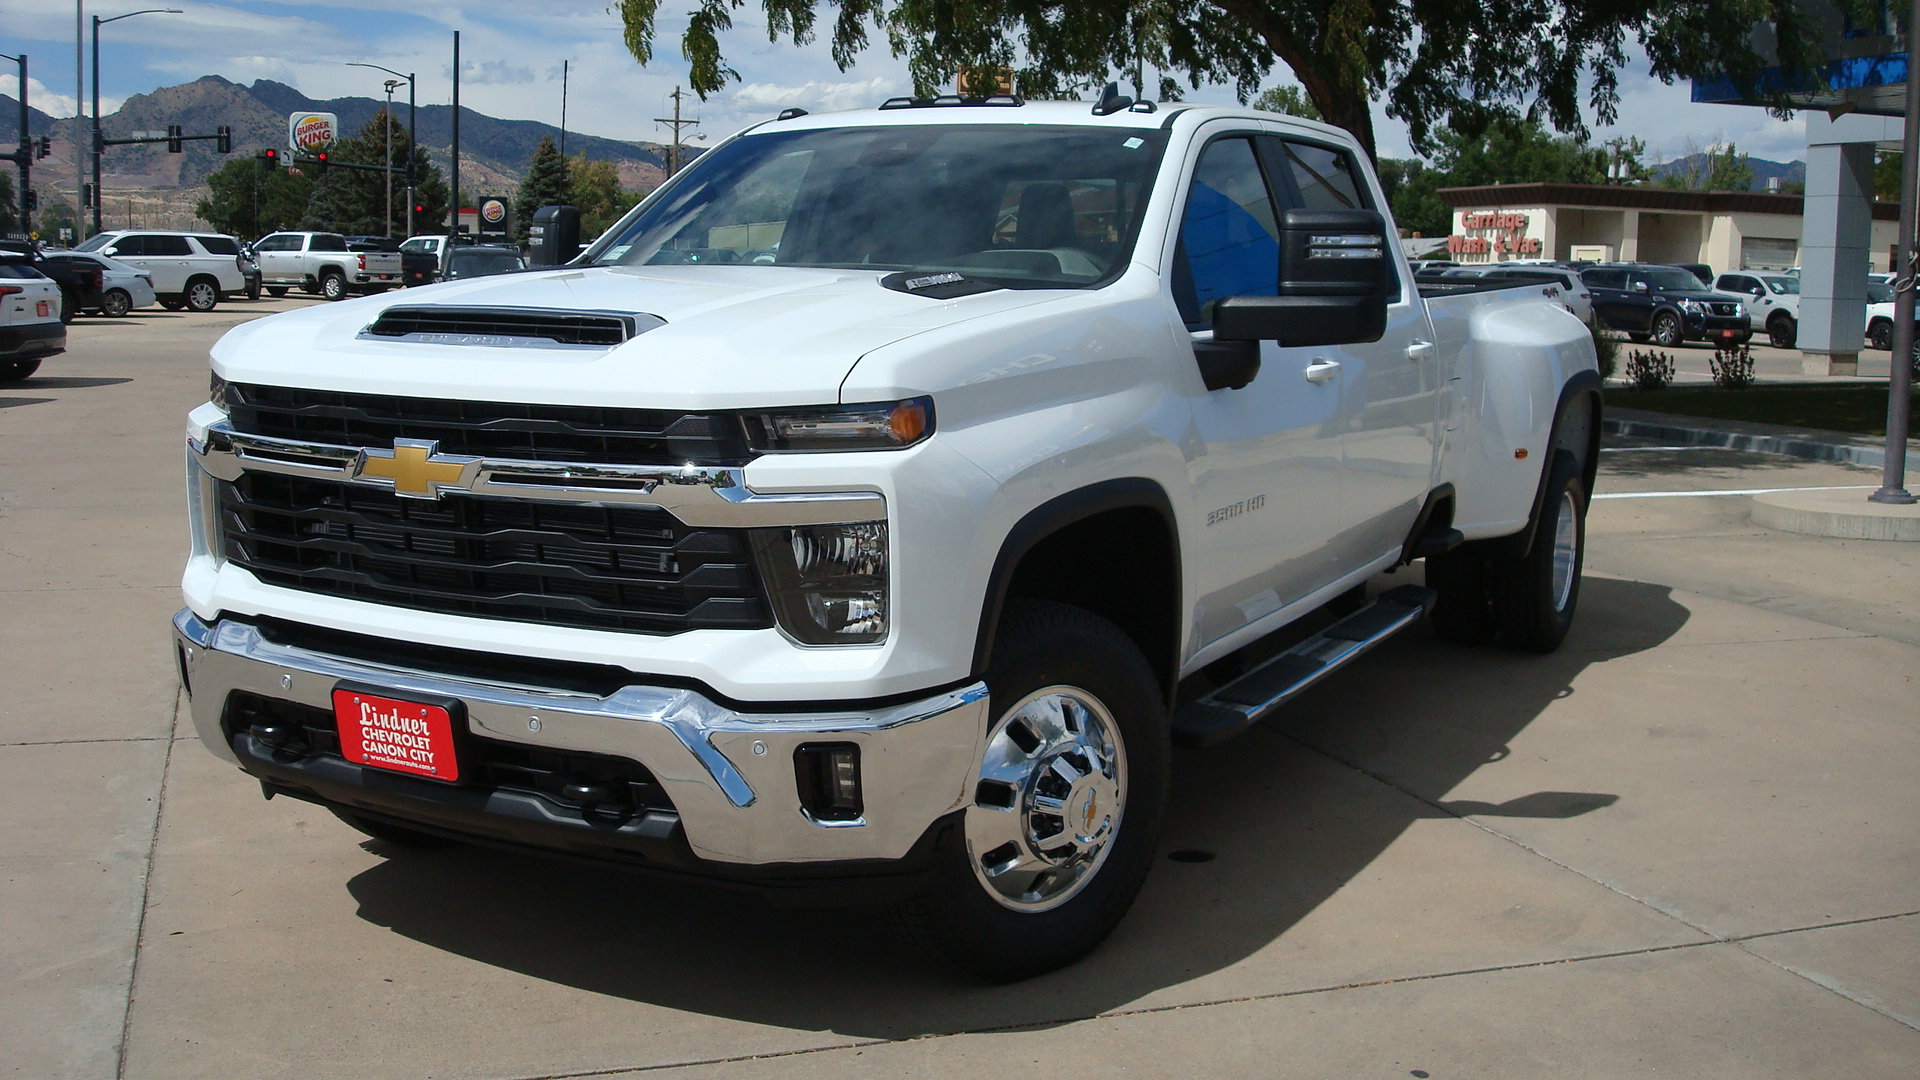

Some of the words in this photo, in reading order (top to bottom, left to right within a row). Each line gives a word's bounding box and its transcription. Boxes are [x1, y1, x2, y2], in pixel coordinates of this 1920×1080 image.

[297, 121, 329, 136] BURGER
[299, 130, 330, 147] KING
[1462, 211, 1525, 232] Carriage
[1447, 234, 1488, 253] Wash
[1493, 234, 1506, 253] &
[1510, 233, 1538, 253] Vac
[1246, 494, 1266, 512] HD
[360, 702, 430, 736] Lindner
[361, 727, 430, 750] CHEVROLET
[361, 740, 407, 758] CANON
[409, 749, 434, 763] CITY
